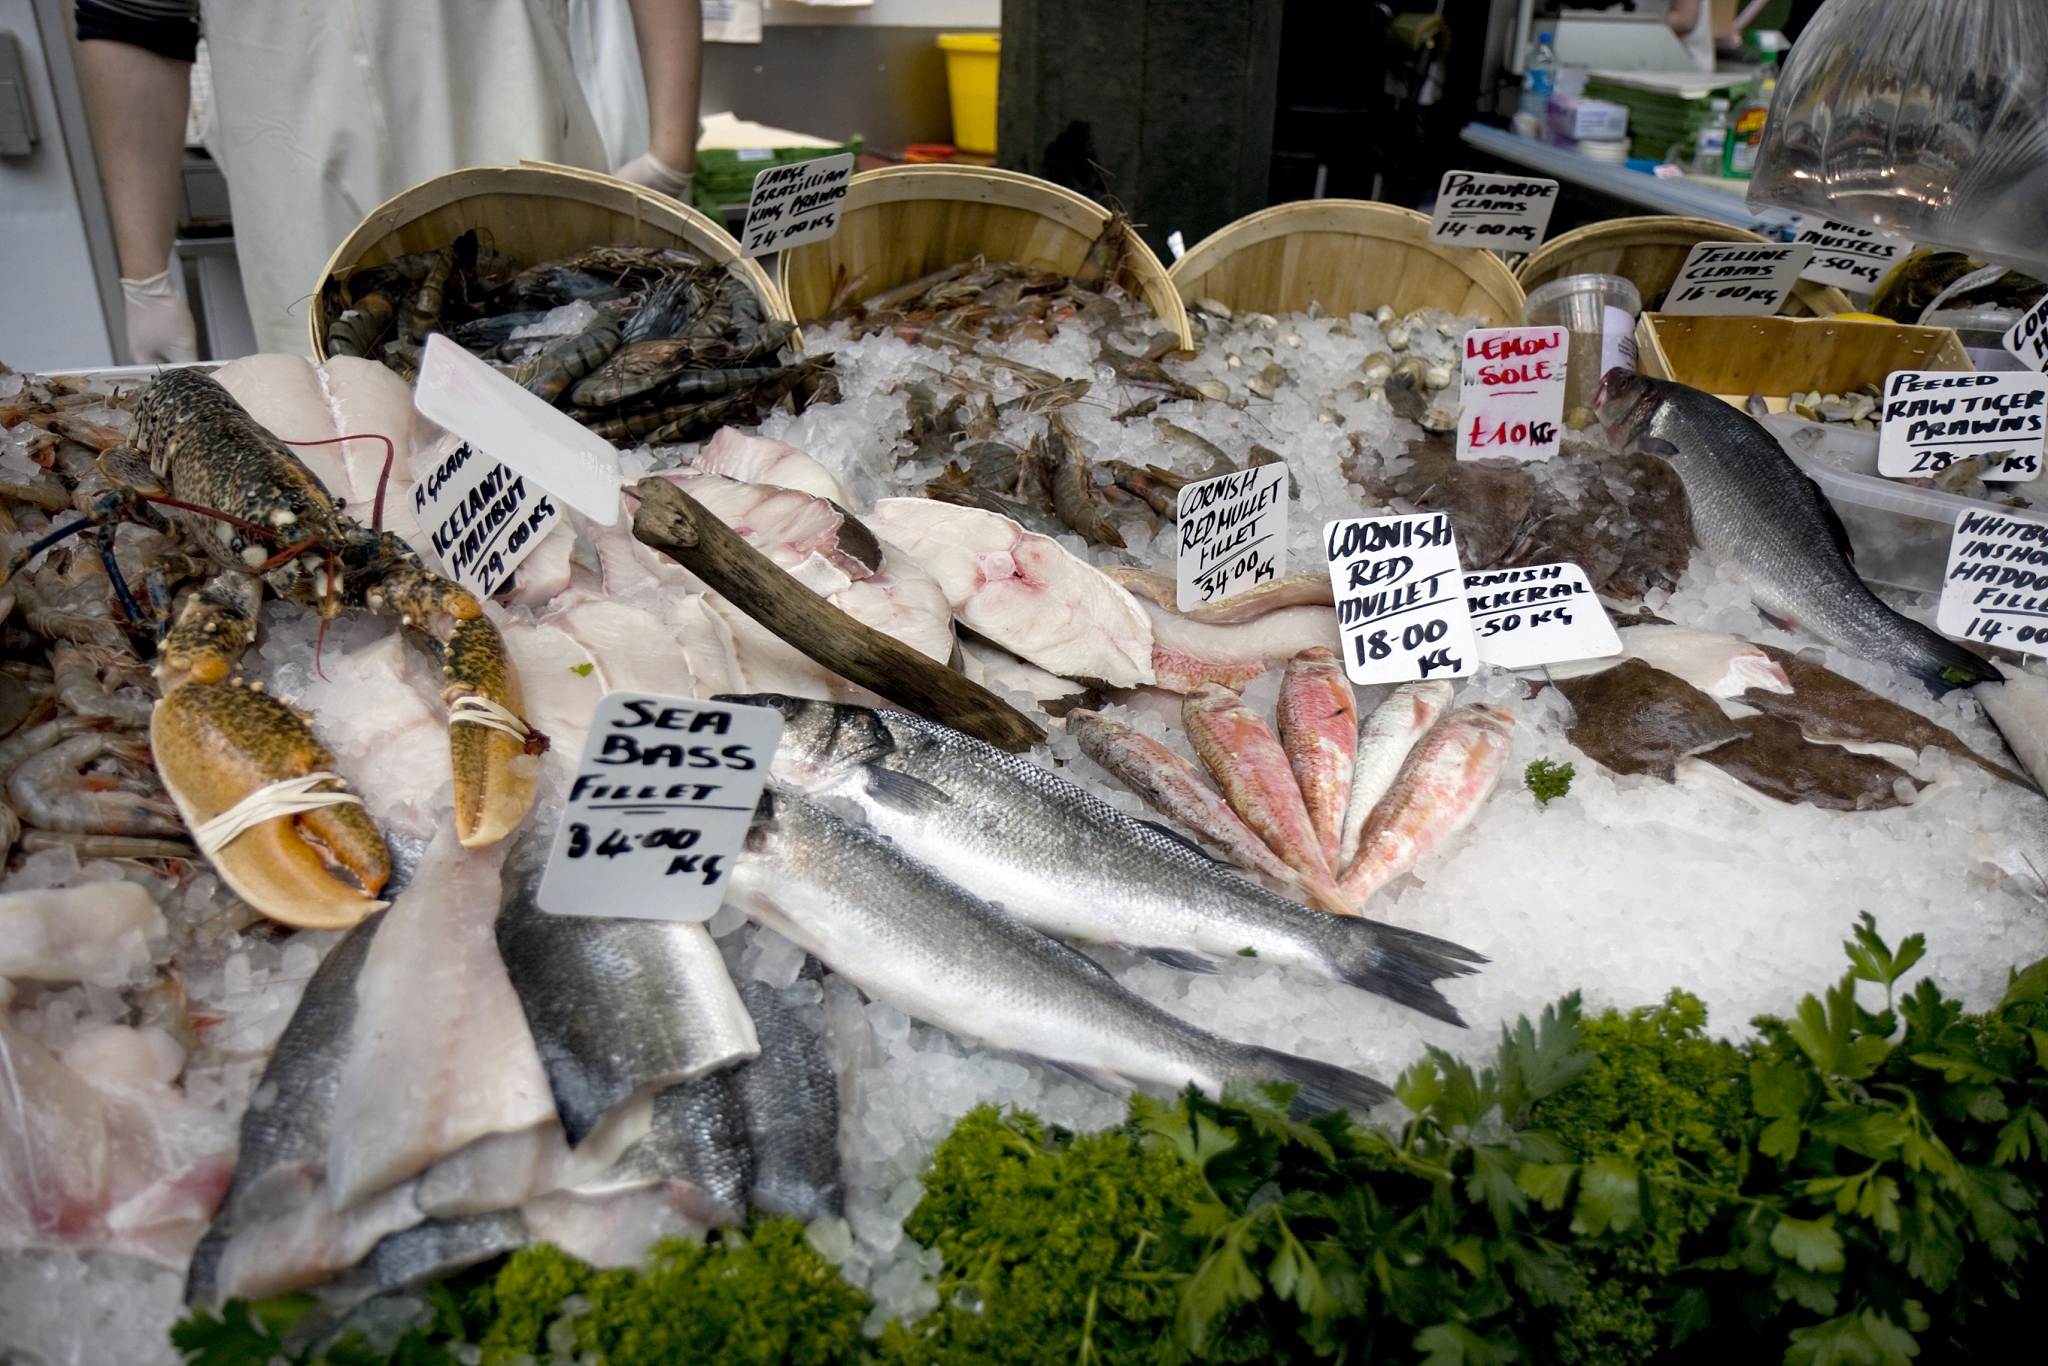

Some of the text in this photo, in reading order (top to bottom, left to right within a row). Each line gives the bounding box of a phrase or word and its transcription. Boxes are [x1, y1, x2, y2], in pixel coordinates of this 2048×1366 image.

[756, 164, 809, 190] LARGE
[1443, 174, 1559, 197] PALOURDE
[747, 185, 848, 227] KING PRAWNS
[1451, 199, 1528, 211] CLAMS
[1689, 246, 1795, 267] TELLINE
[1798, 230, 1896, 257] MUSSELS
[1685, 265, 1775, 280] CLAMS
[1467, 333, 1559, 361] LEMON
[1478, 361, 1552, 386] SOLE
[1890, 374, 1999, 396] PEELED
[1885, 390, 2046, 423] RAW TIGER
[1906, 415, 2042, 442] PRAWNS
[416, 441, 473, 515] A GRADE
[1180, 468, 1259, 519] CORNISH
[452, 475, 527, 582] HALIBUT
[1180, 476, 1283, 557] RED MULLET
[1200, 512, 1268, 570] FILLET
[1329, 515, 1452, 562] CORNISH
[1345, 555, 1413, 592] RED
[1338, 568, 1457, 626] MULLET
[1530, 607, 1573, 628] KG
[1417, 646, 1462, 679] KG
[611, 701, 733, 735] SEA
[593, 734, 757, 770] BASS
[569, 774, 724, 802] FILLET
[665, 854, 727, 886] KG
